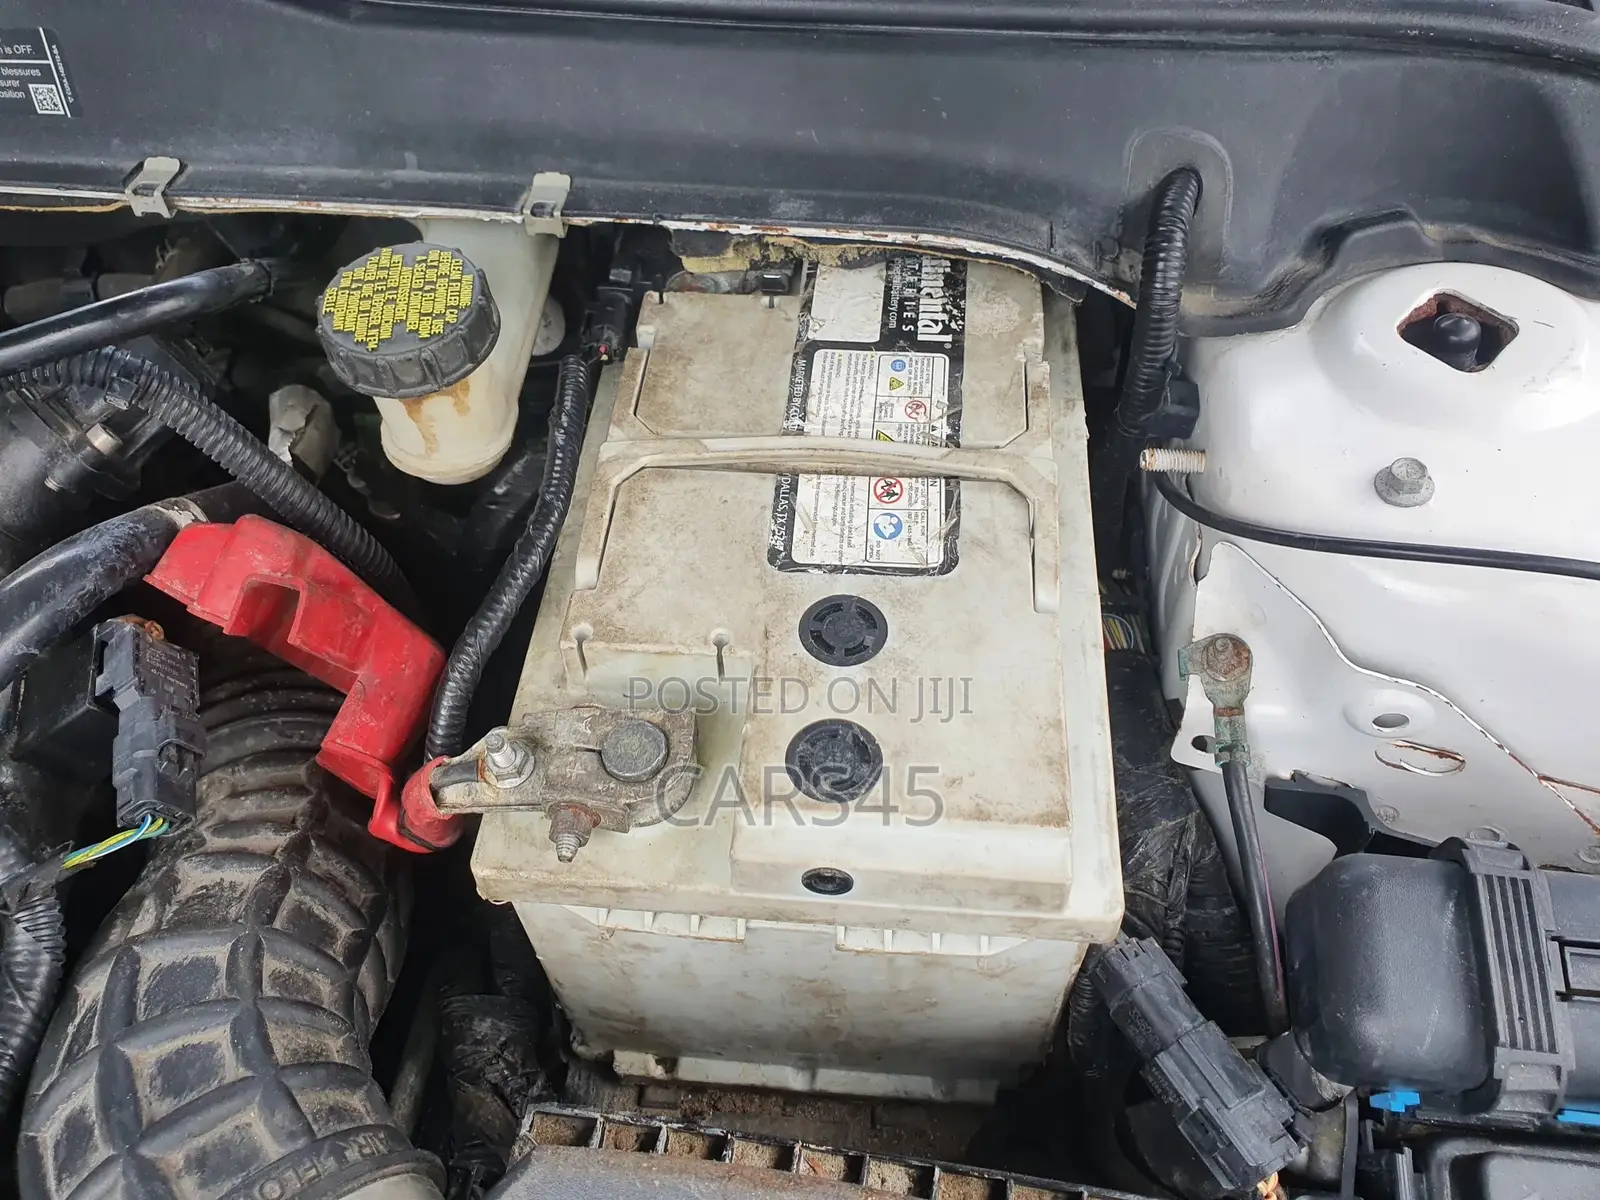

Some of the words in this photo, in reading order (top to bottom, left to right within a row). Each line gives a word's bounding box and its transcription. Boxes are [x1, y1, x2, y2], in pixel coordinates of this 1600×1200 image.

[5, 45, 12, 54] is
[14, 44, 35, 54] OFF.
[1, 67, 41, 76] blessures
[794, 360, 806, 396] MARKETED
[790, 398, 801, 407] BY
[776, 477, 791, 512] DALLAS,
[776, 513, 787, 524] TX
